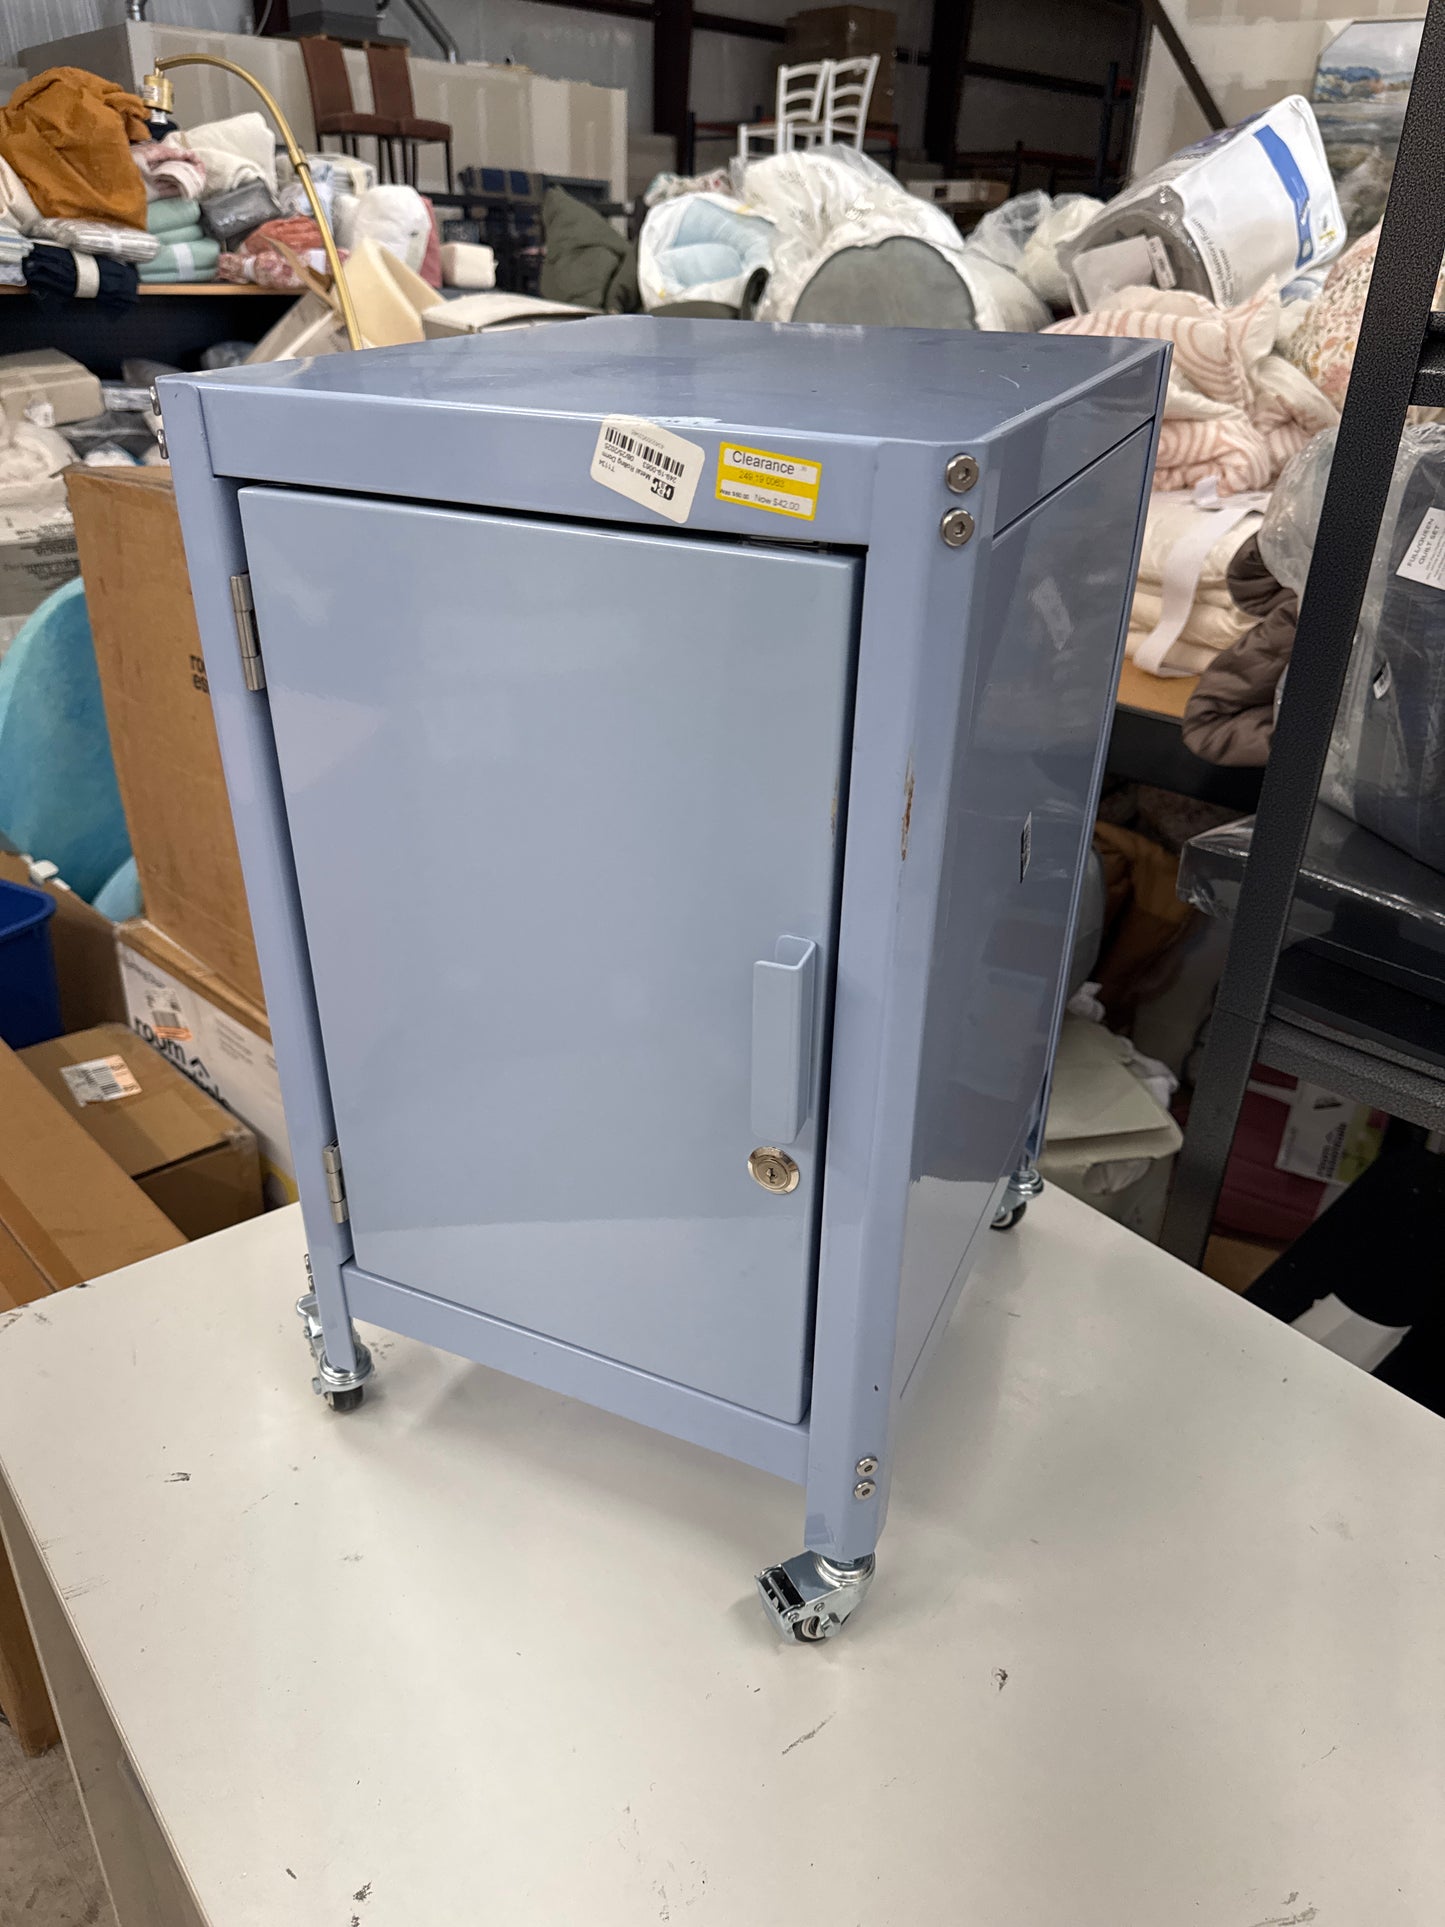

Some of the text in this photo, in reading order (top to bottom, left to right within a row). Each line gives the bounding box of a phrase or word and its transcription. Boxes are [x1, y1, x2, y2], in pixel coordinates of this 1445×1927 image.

[732, 450, 795, 474] Clearance
[1406, 518, 1435, 567] FULL/QUEEN
[1418, 542, 1432, 565] QUILT
[1429, 525, 1440, 540] SET
